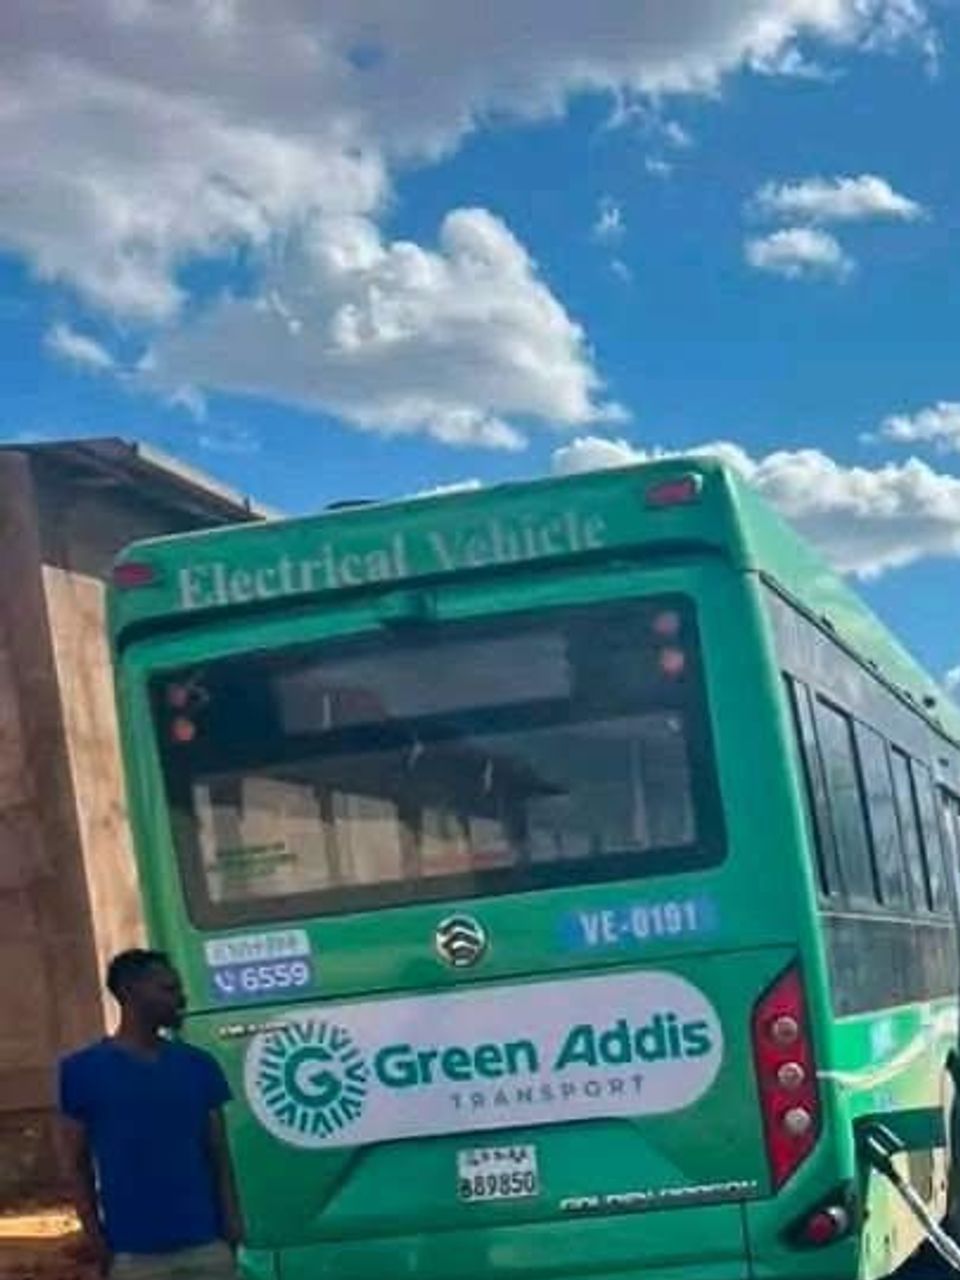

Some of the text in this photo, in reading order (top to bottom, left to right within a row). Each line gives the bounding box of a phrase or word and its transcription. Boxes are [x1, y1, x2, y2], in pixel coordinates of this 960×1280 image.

[177, 511, 607, 609] Electrical Vehicle
[242, 961, 309, 991] 6559
[285, 1046, 343, 1107] G
[374, 1012, 712, 1088] Green Addis
[452, 1074, 644, 1110] TRANSPORT
